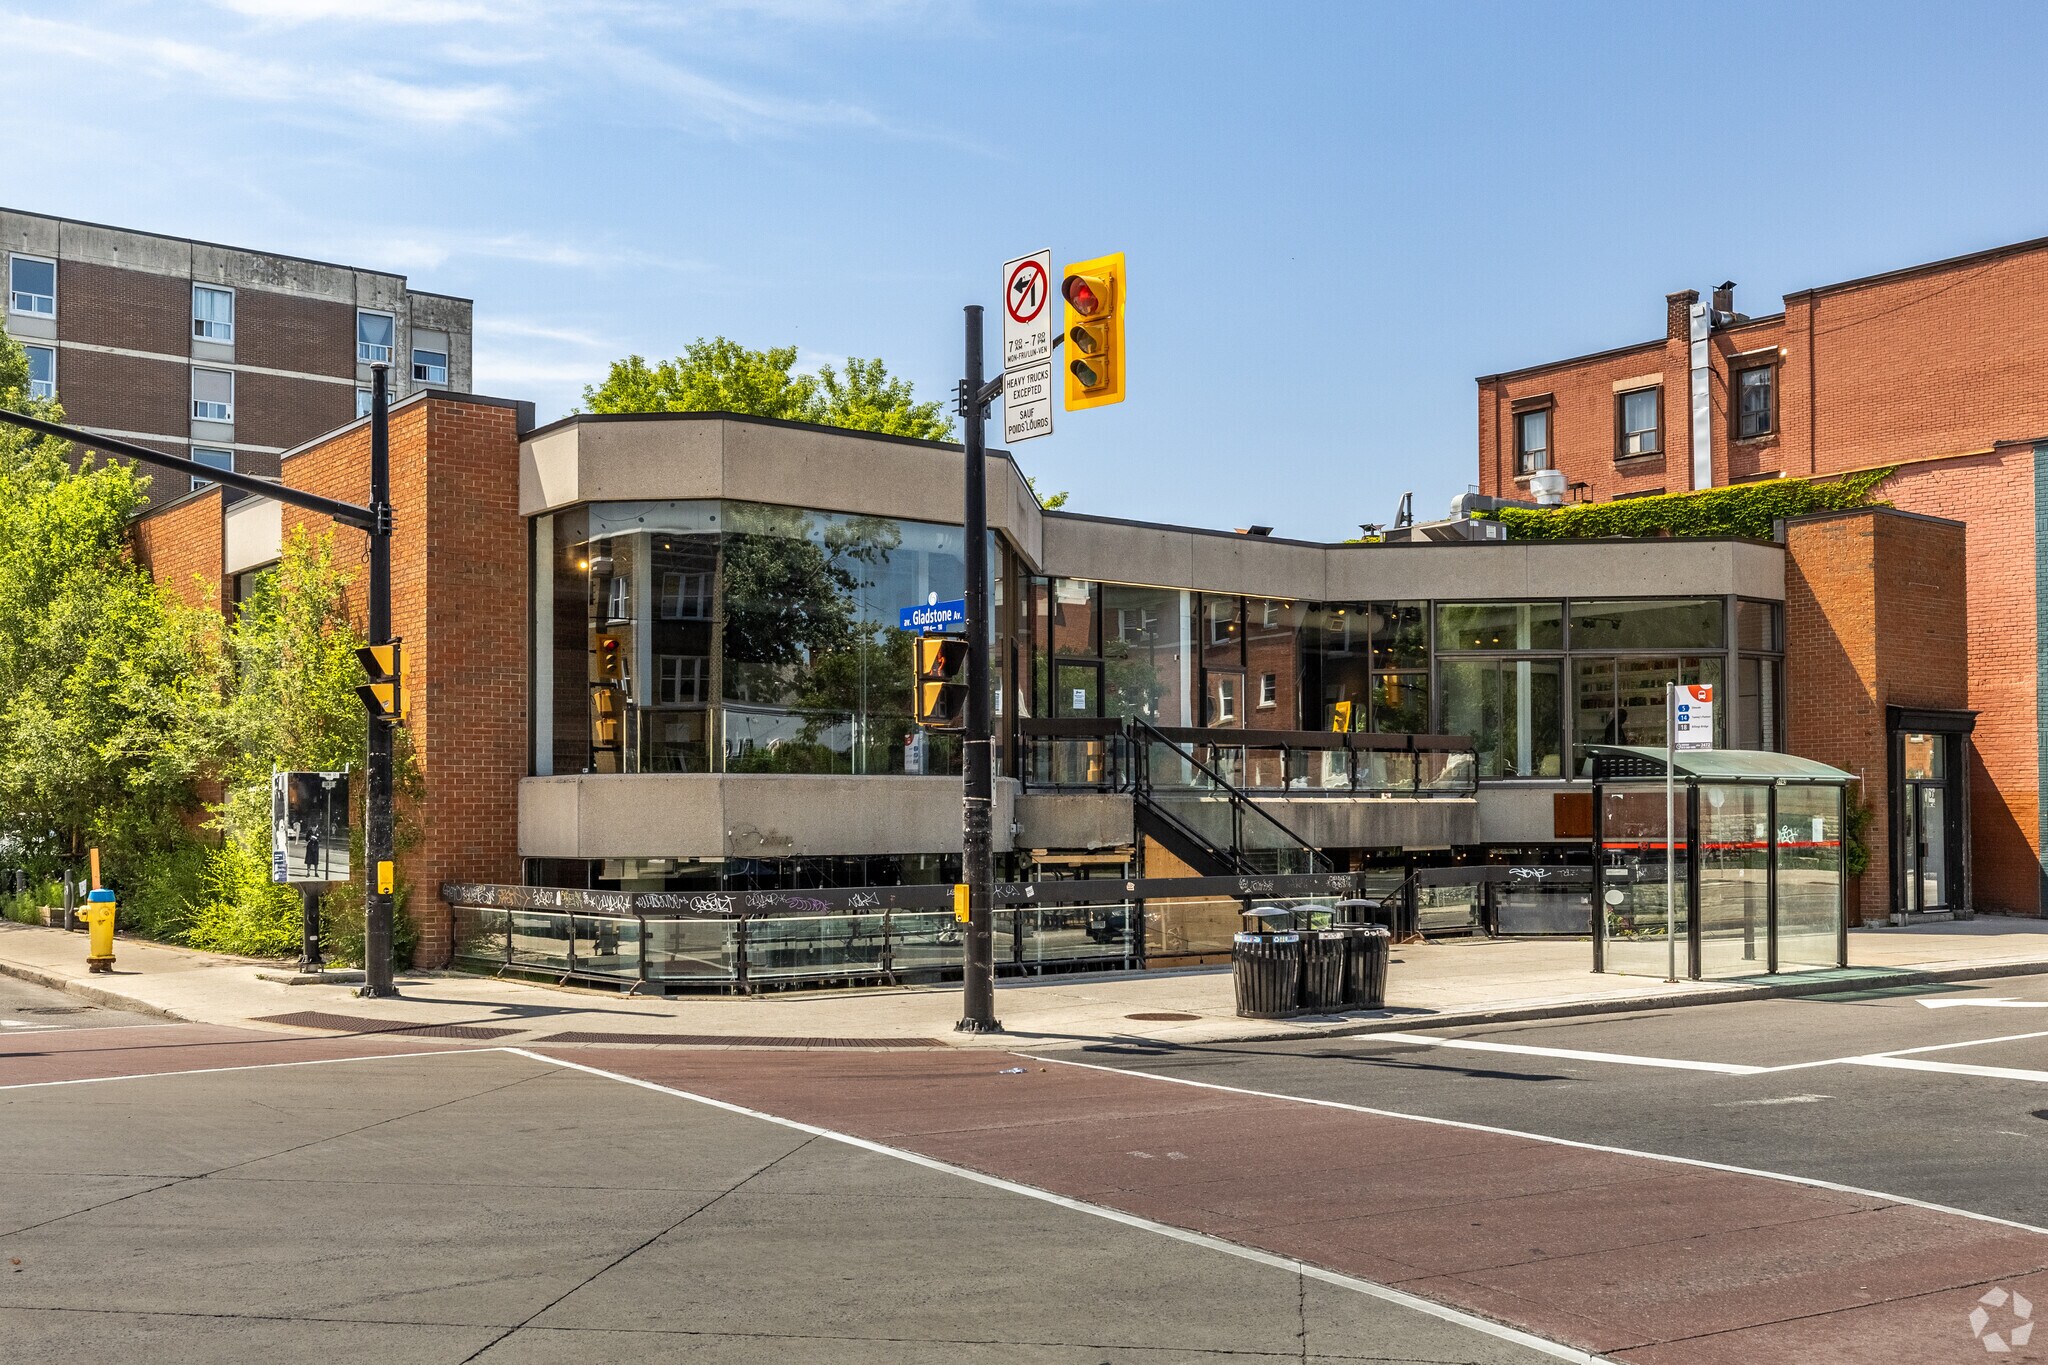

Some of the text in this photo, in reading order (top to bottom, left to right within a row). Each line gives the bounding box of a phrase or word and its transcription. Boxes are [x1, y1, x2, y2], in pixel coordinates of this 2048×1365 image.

[1006, 370, 1049, 389] HEAVY TRUCKS
[1013, 384, 1042, 400] EXCEPTED
[1020, 408, 1035, 420] SAUF
[1008, 422, 1025, 435] POIDS
[912, 608, 952, 626] Gladstone
[953, 610, 962, 620] Av.
